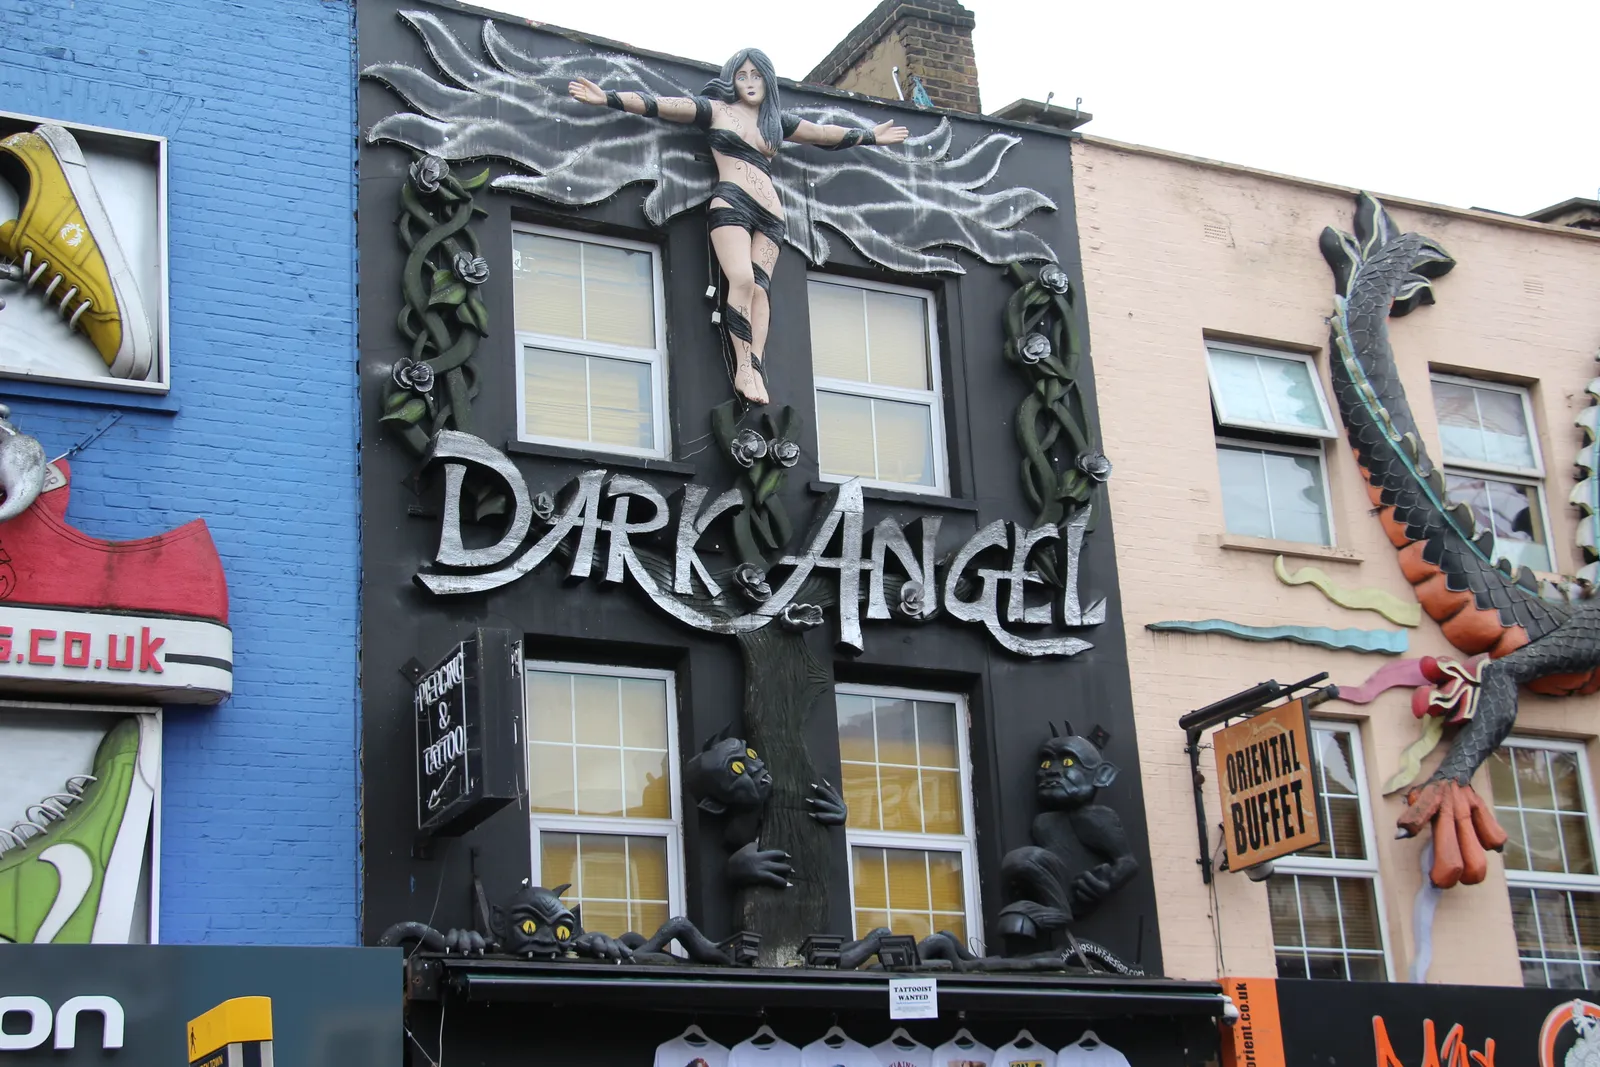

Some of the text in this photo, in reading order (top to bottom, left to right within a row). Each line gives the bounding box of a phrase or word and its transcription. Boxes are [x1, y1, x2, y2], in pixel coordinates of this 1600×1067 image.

[413, 430, 1108, 657] DARK ANGEL
[416, 651, 464, 712] PIERCING
[438, 701, 451, 729] &
[423, 725, 466, 776] TATTOO
[1226, 730, 1300, 795] ORIENTAL
[1231, 779, 1306, 855] BUFFET
